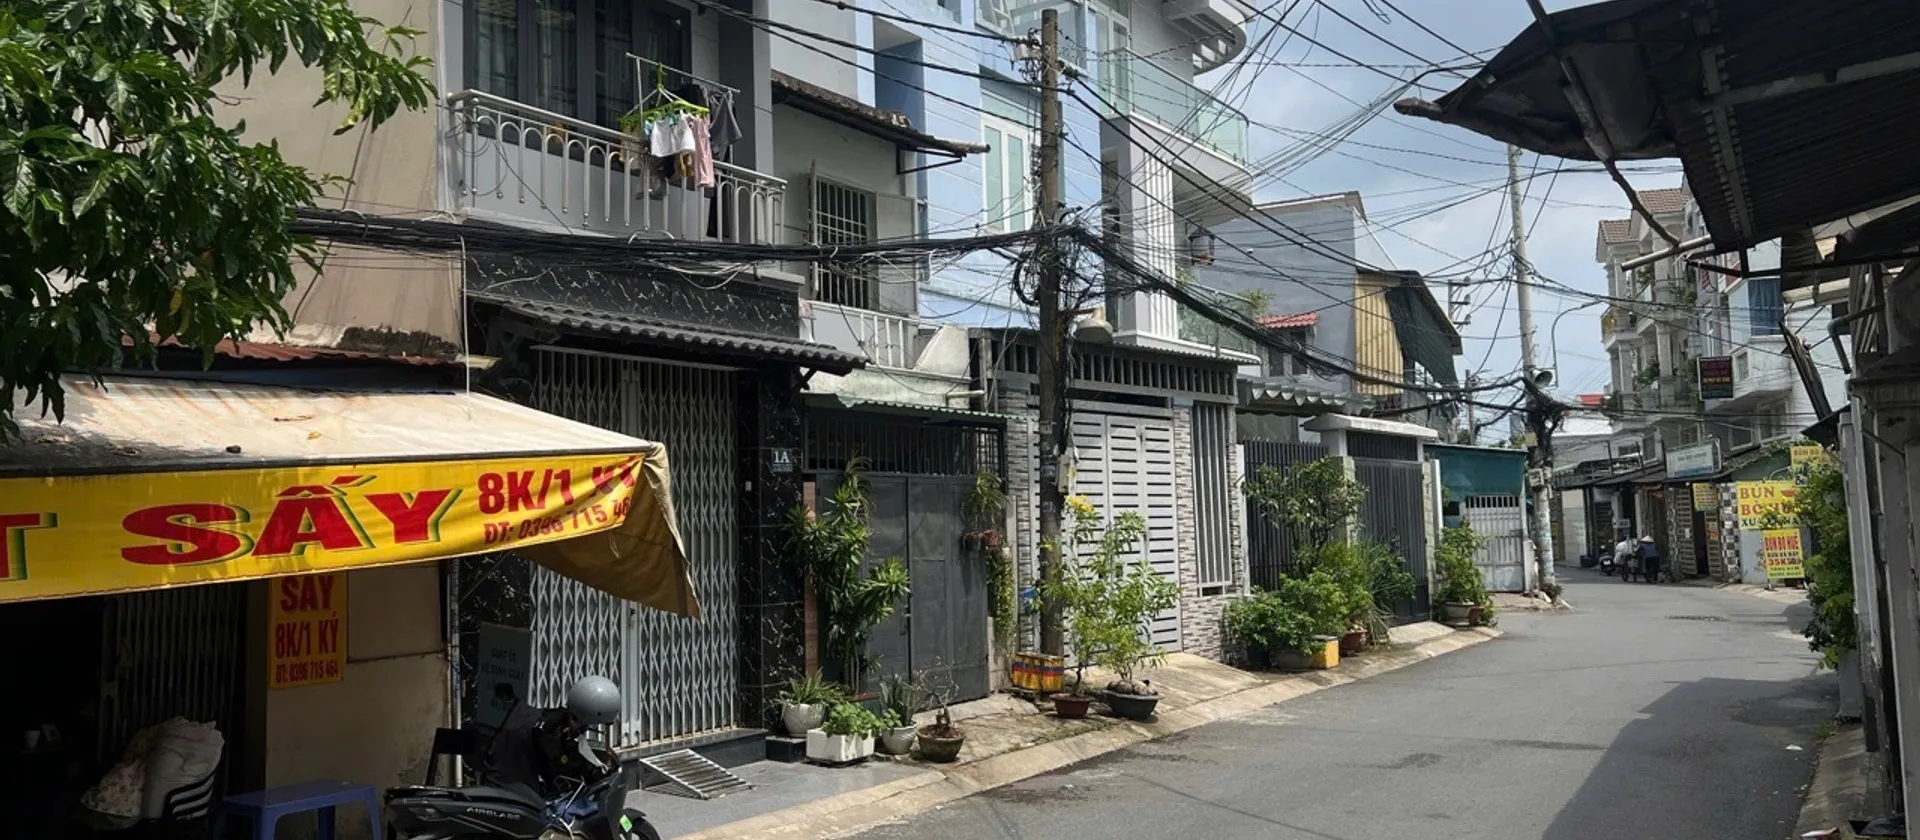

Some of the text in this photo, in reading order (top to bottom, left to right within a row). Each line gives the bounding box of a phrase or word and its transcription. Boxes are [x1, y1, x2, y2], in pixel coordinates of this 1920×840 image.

[773, 450, 790, 463] 1A
[478, 468, 575, 515] 8K/1
[1740, 484, 1775, 499] BÚN
[121, 474, 462, 566] SẤY
[484, 521, 514, 545] ĐT:
[568, 504, 608, 529] 715
[275, 611, 340, 659] 8K/1 KÝ
[310, 660, 324, 679] 715
[325, 658, 340, 678] 464
